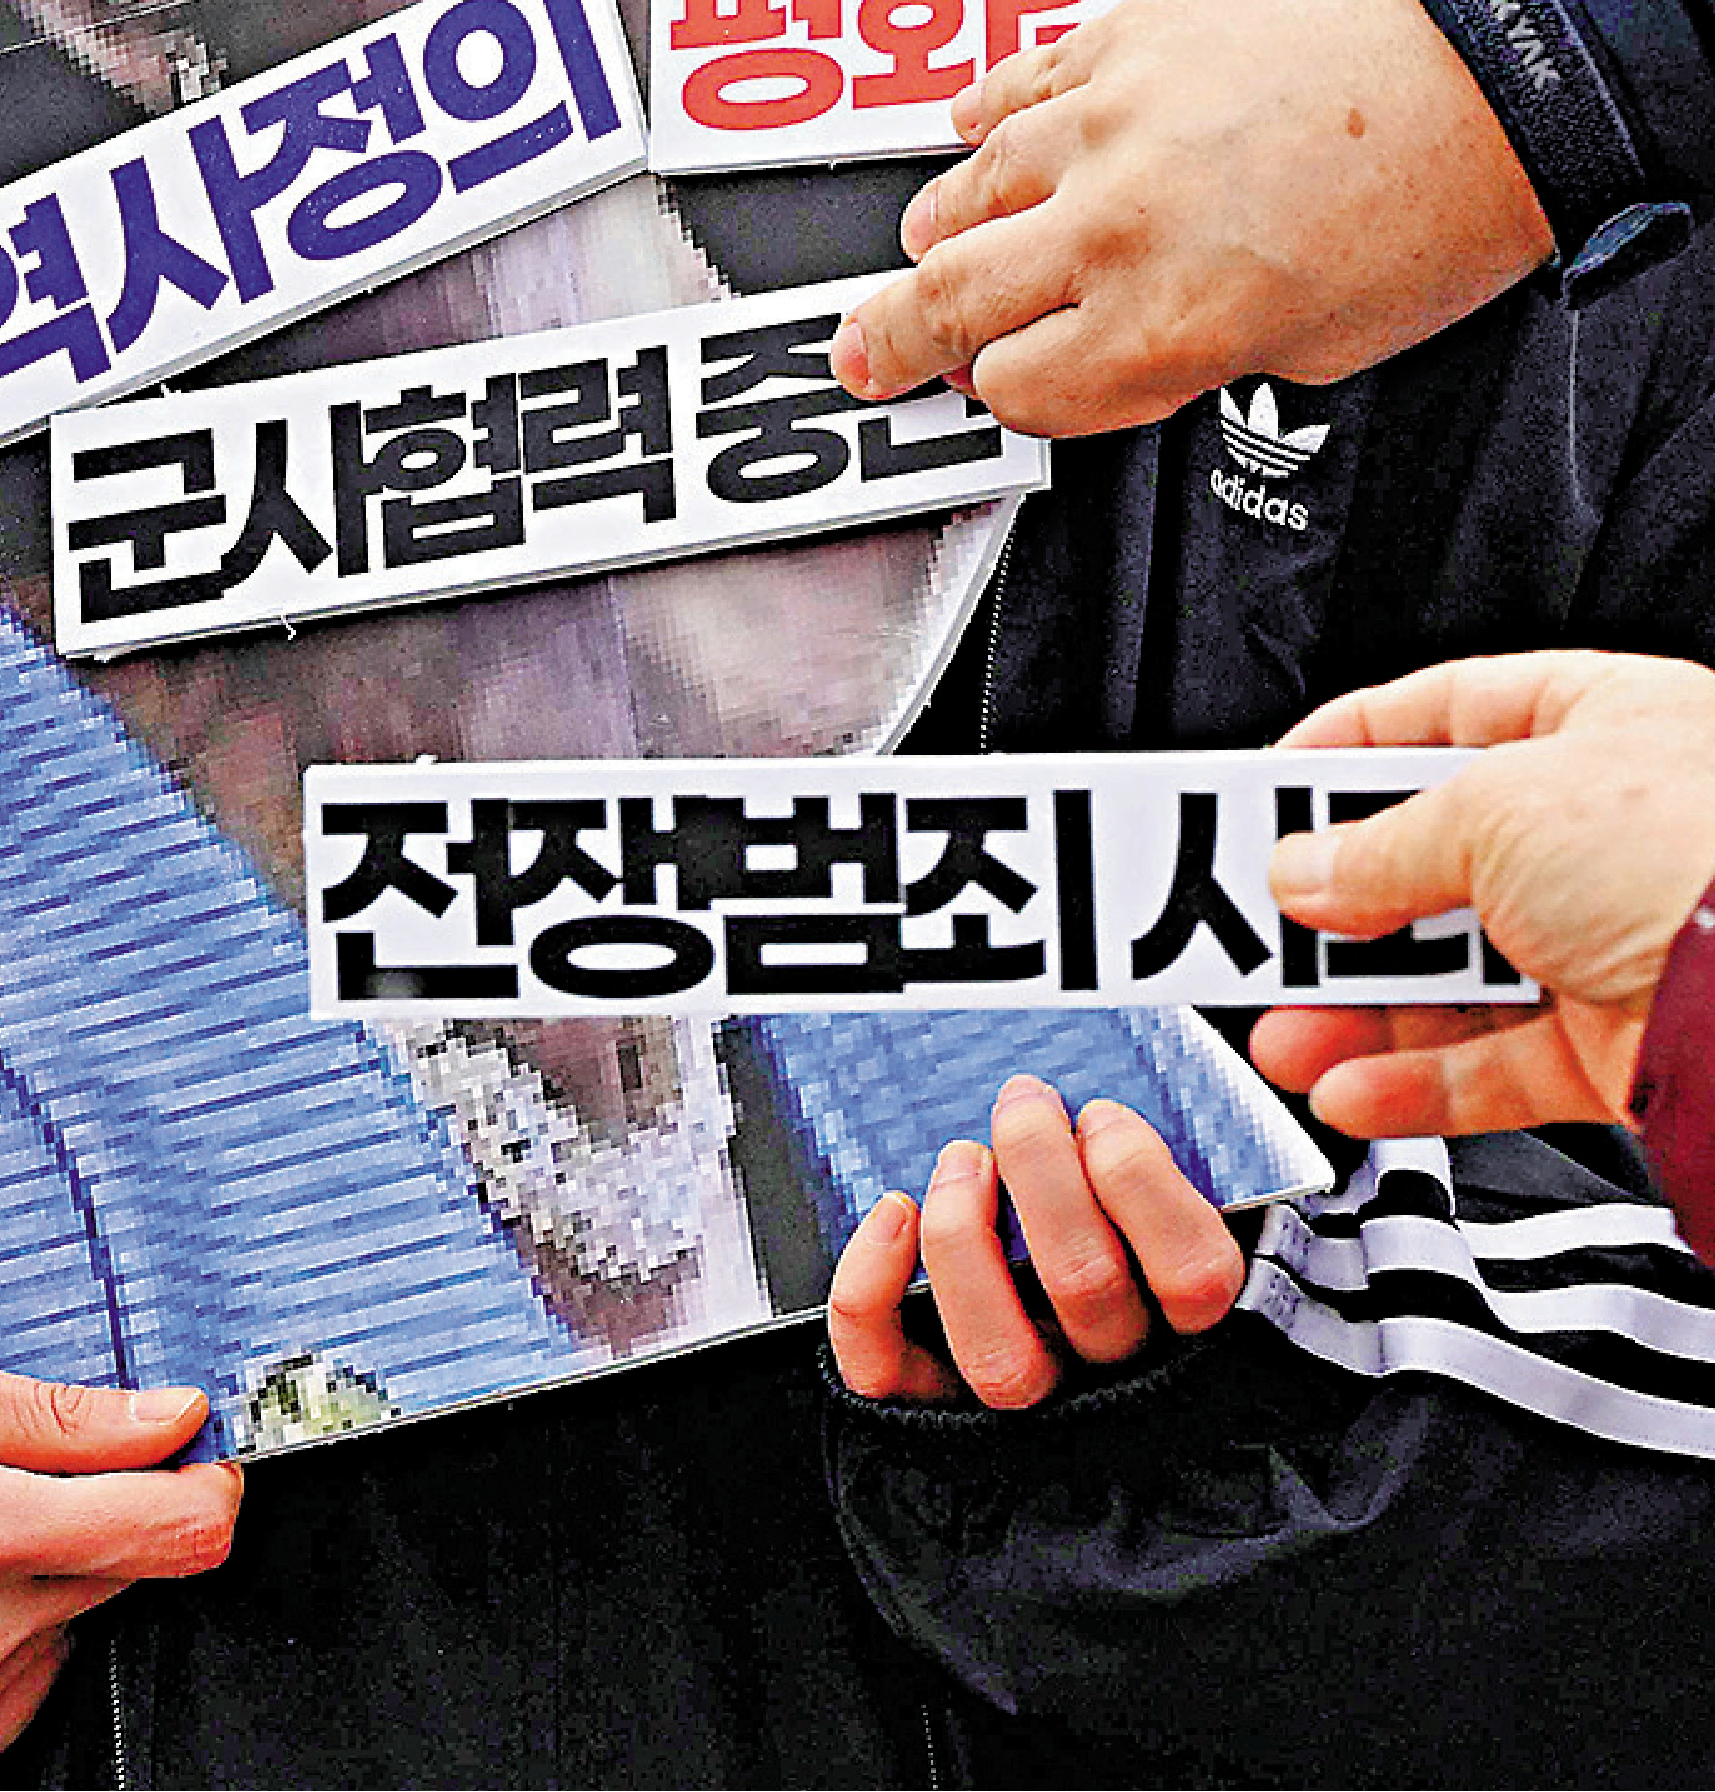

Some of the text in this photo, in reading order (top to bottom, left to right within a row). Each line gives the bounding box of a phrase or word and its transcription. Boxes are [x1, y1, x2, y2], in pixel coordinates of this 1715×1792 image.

[67, 345, 677, 625] 군사협력
[1210, 468, 1310, 531] adidas
[320, 788, 1099, 999] 전쟁범죄
